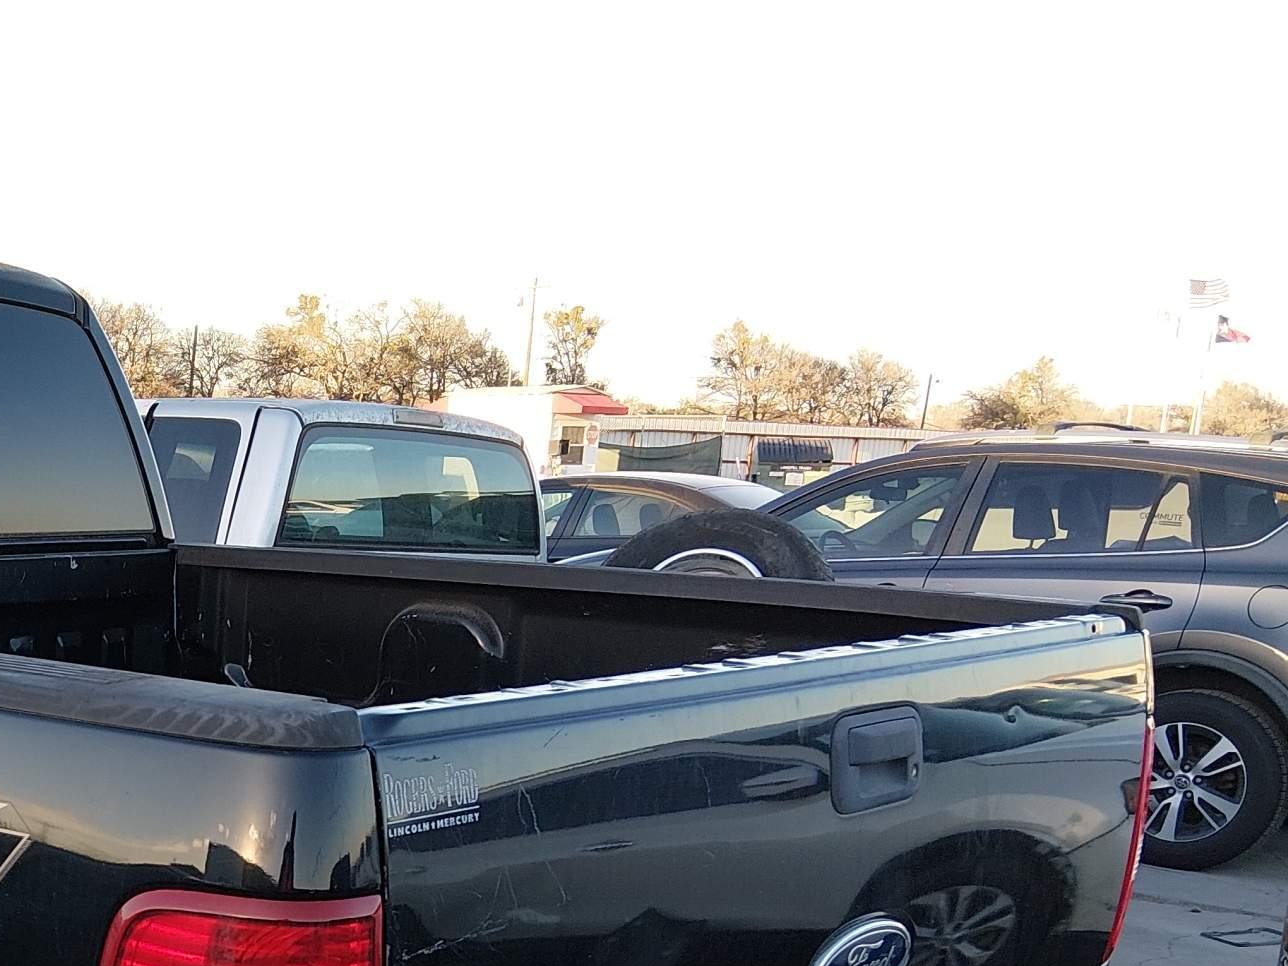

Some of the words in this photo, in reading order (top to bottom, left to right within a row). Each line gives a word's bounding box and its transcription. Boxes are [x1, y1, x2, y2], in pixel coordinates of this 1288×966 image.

[443, 763, 480, 808] FORD
[388, 821, 430, 838] LINCOLN
[436, 812, 480, 829] MERCURY
